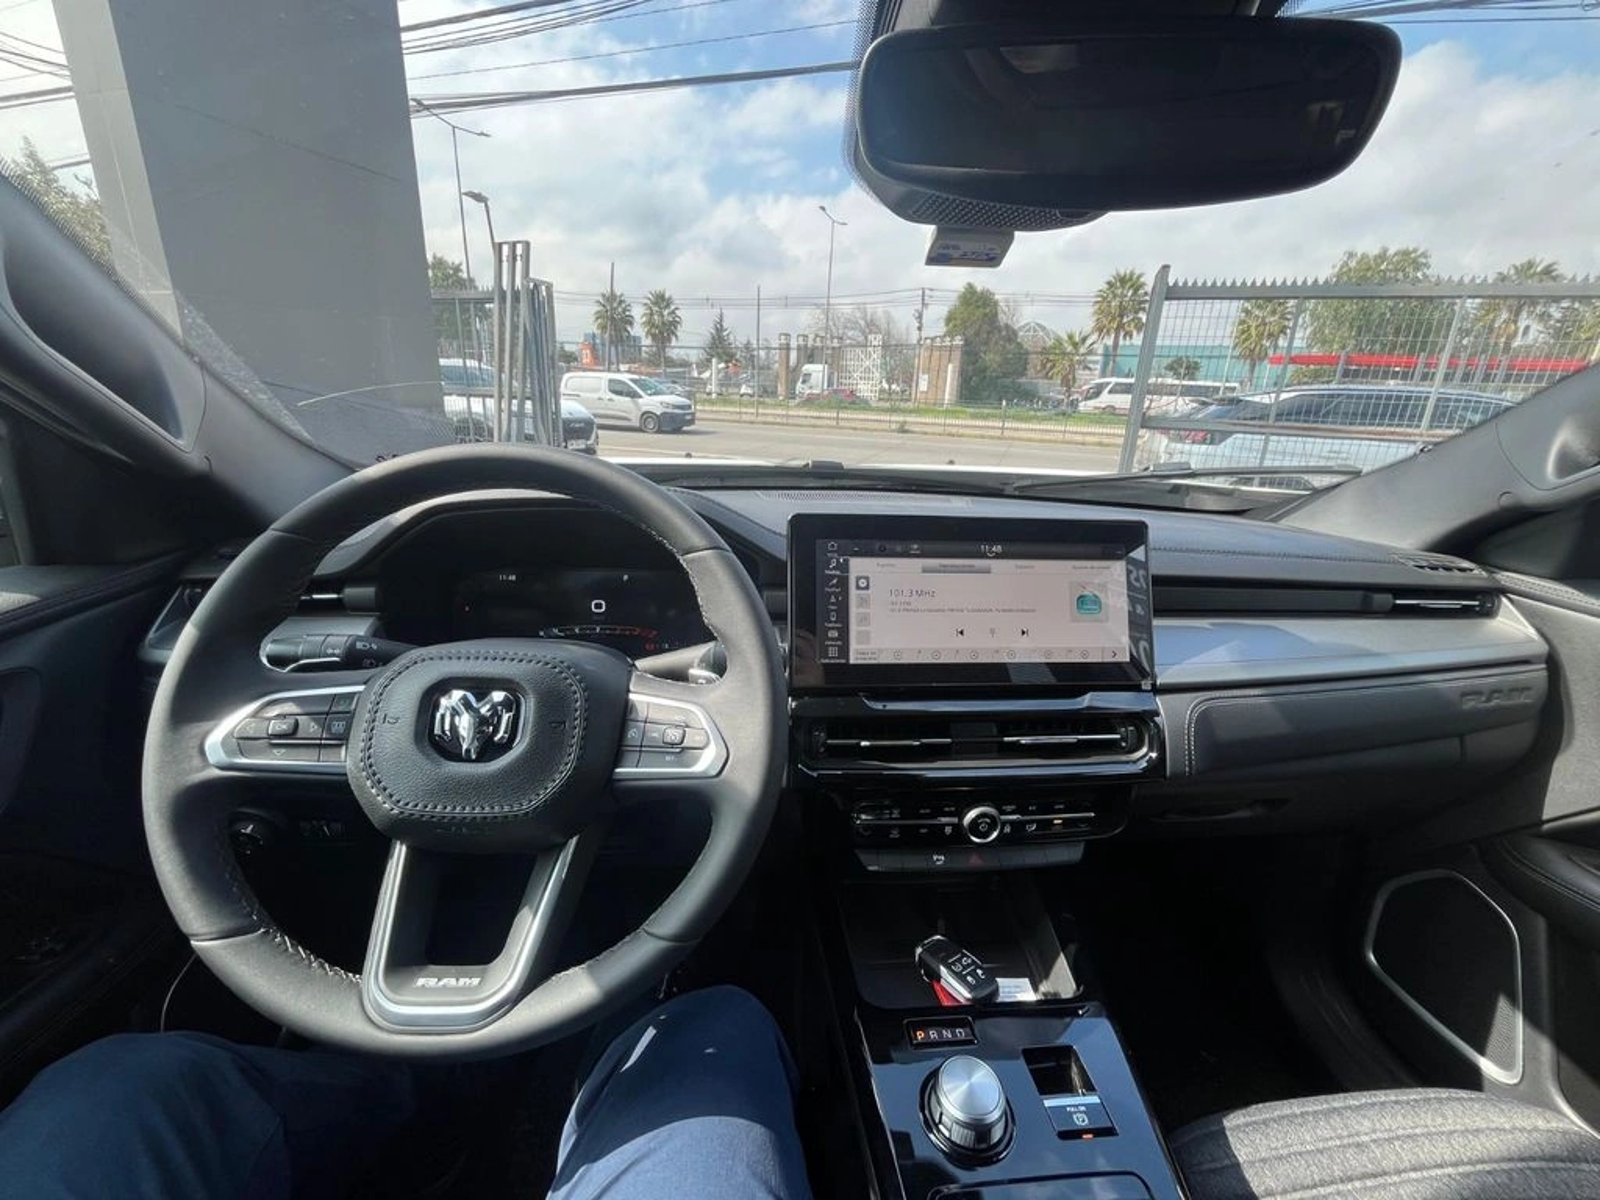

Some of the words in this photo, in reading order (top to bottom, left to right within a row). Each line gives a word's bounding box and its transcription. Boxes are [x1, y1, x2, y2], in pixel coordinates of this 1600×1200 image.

[980, 544, 1002, 553] 11:48
[889, 589, 913, 598] 101.3
[915, 589, 936, 598] MHz
[416, 977, 481, 988] RAM
[916, 1030, 925, 1041] P
[929, 1030, 938, 1039] R
[942, 1029, 952, 1038] N
